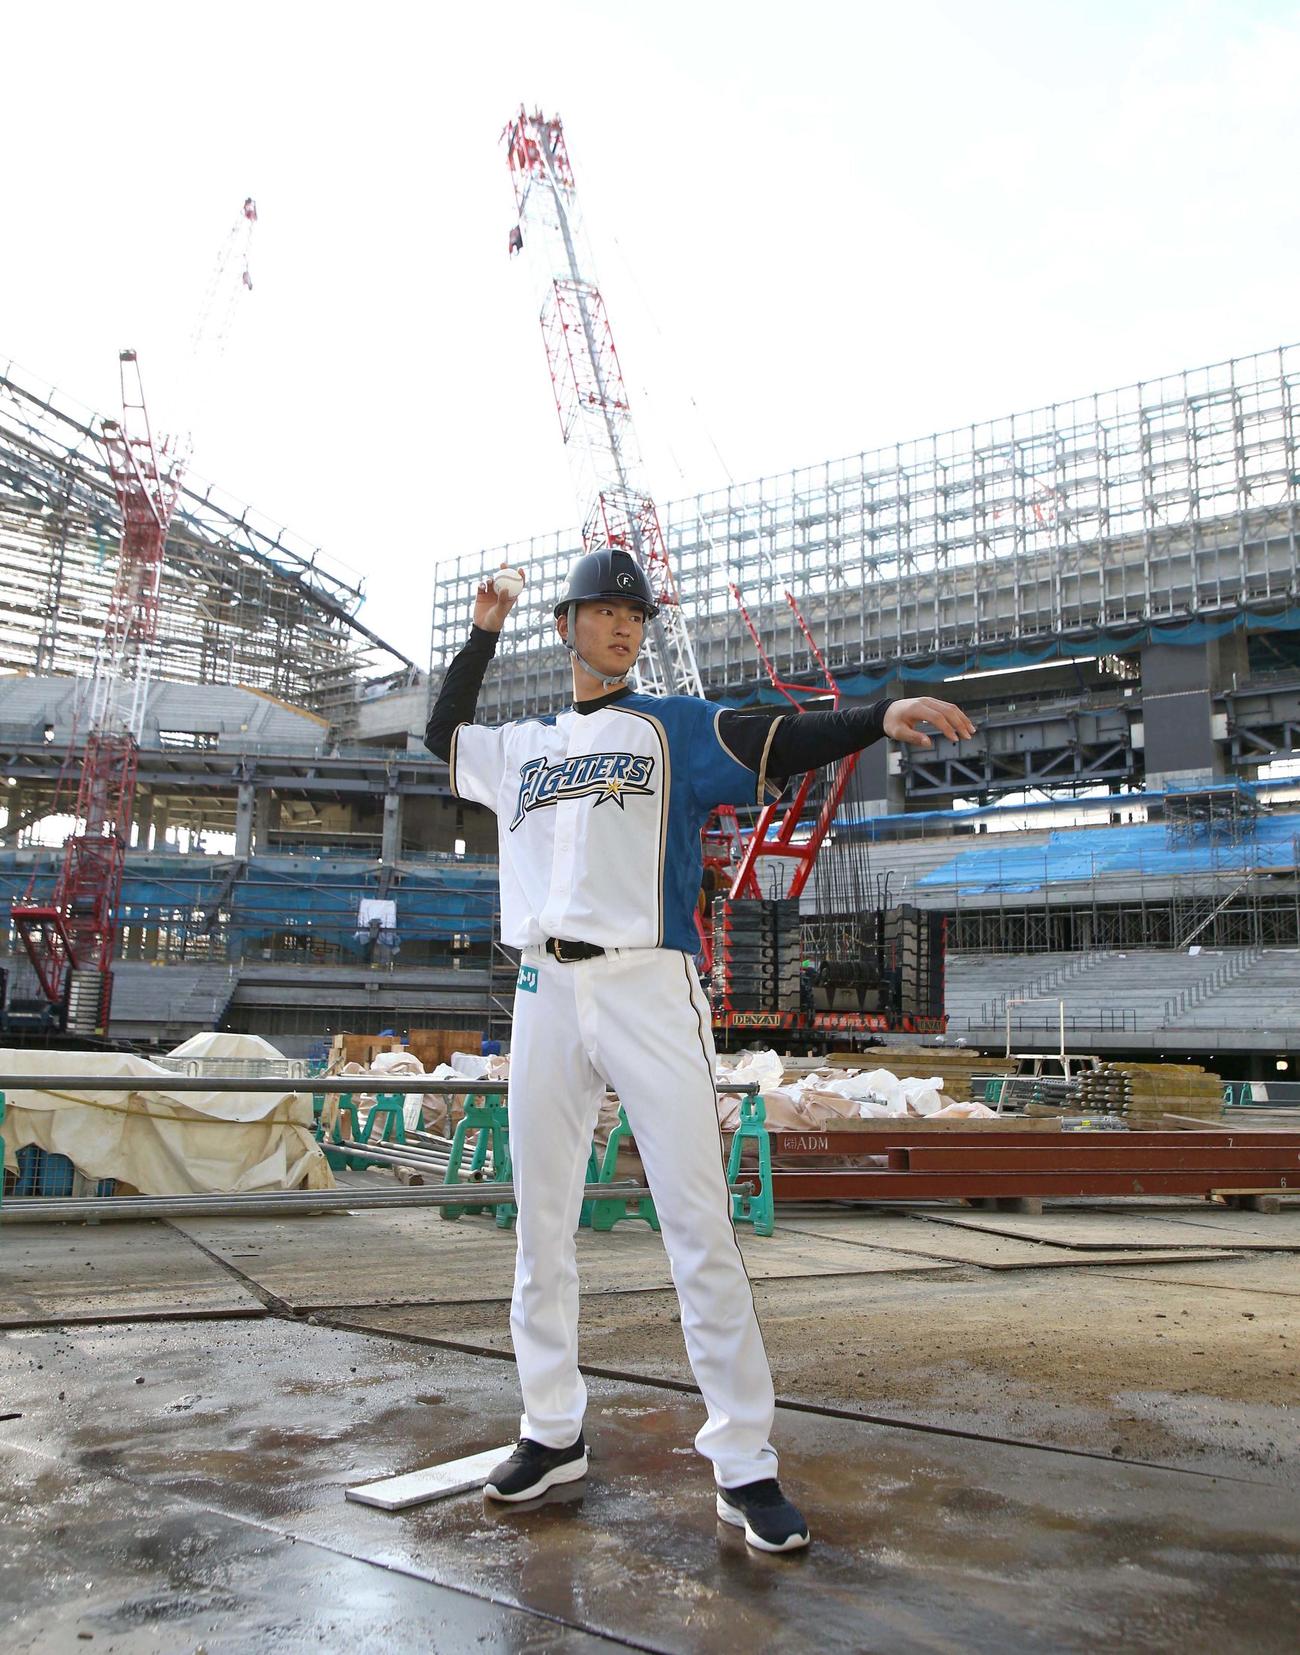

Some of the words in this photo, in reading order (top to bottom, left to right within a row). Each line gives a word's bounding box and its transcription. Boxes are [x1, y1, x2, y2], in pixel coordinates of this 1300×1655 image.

[509, 752, 655, 832] FIGHTERS
[733, 1013, 780, 1026] DENZAI
[1280, 1176, 1287, 1188] 6
